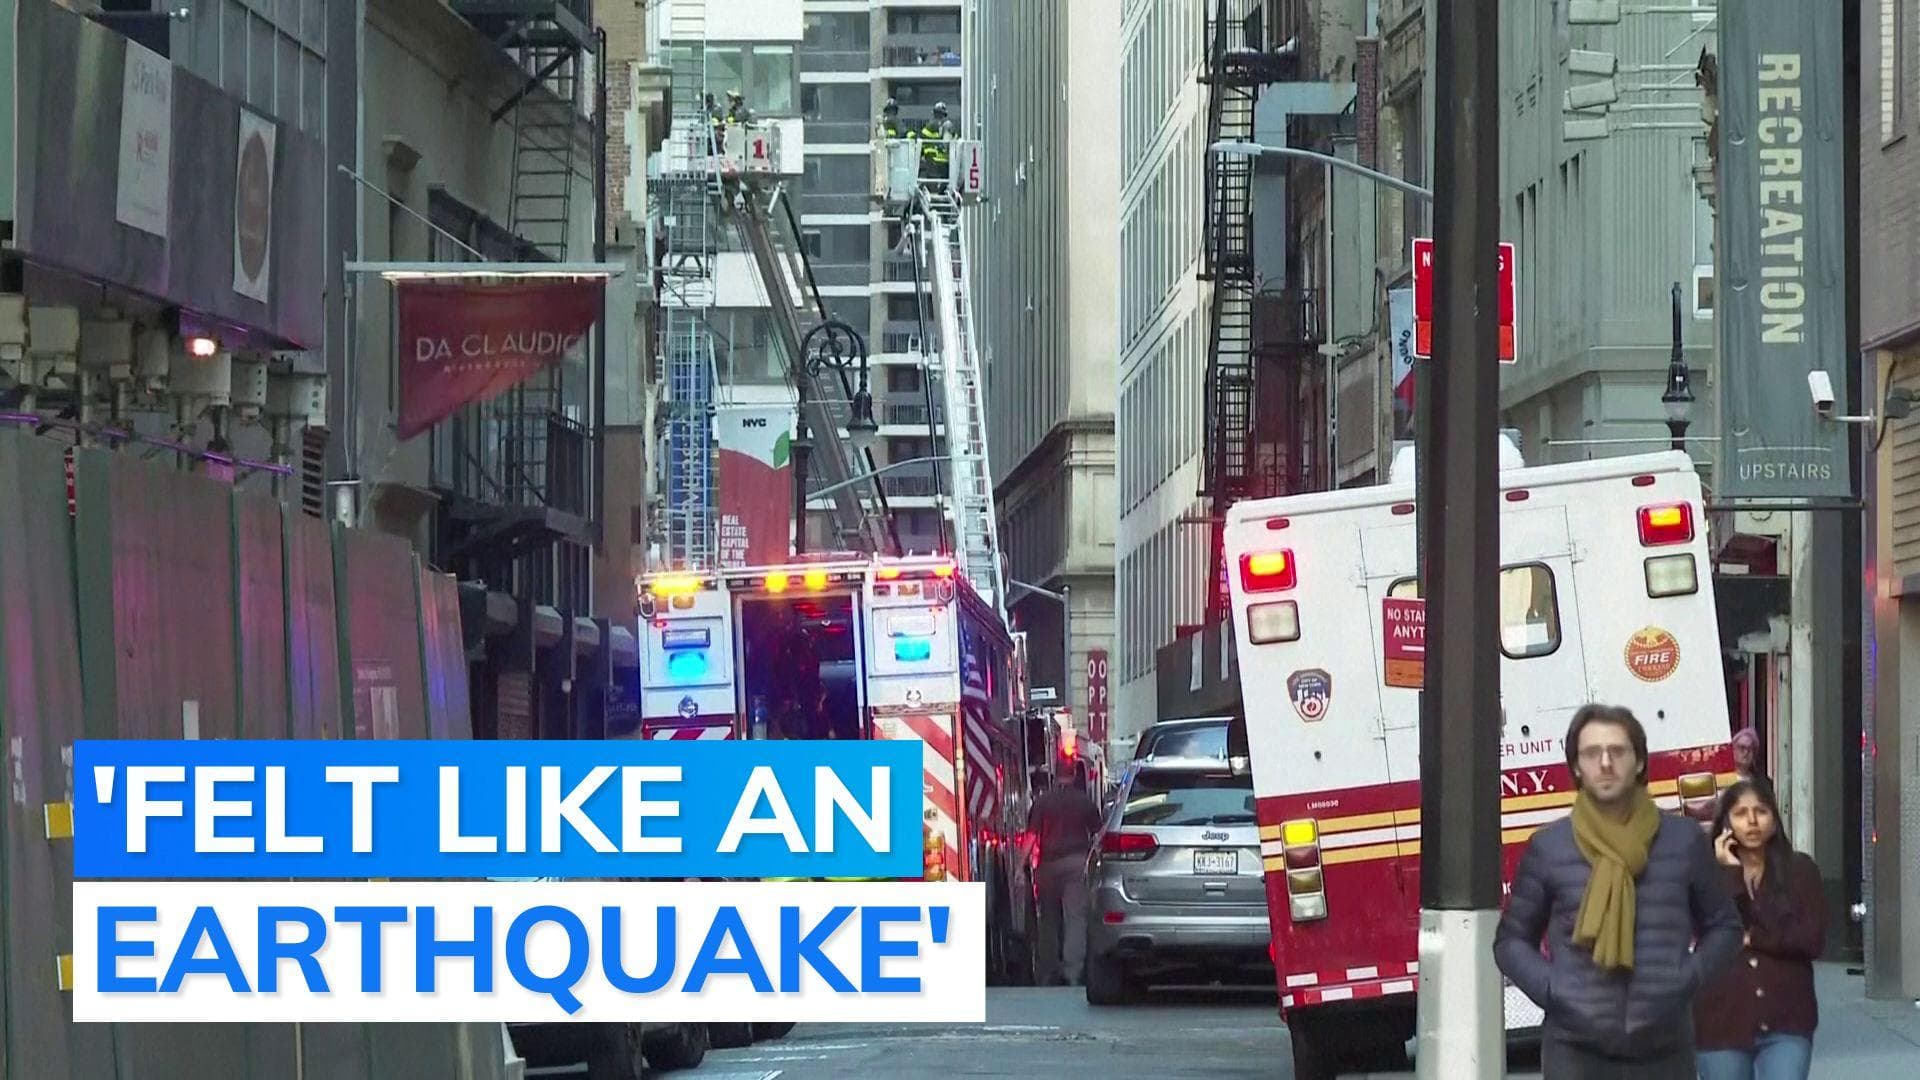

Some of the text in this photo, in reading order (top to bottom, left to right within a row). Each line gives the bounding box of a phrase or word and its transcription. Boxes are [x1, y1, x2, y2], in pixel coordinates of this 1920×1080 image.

[753, 138, 765, 159] 1
[1758, 53, 1805, 343] RECREATION
[415, 336, 453, 362] DA
[742, 418, 767, 428] NYC
[1739, 462, 1831, 480] UPSTAIRS
[1634, 651, 1671, 666] FIRE
[1520, 739, 1552, 755] UNIT
